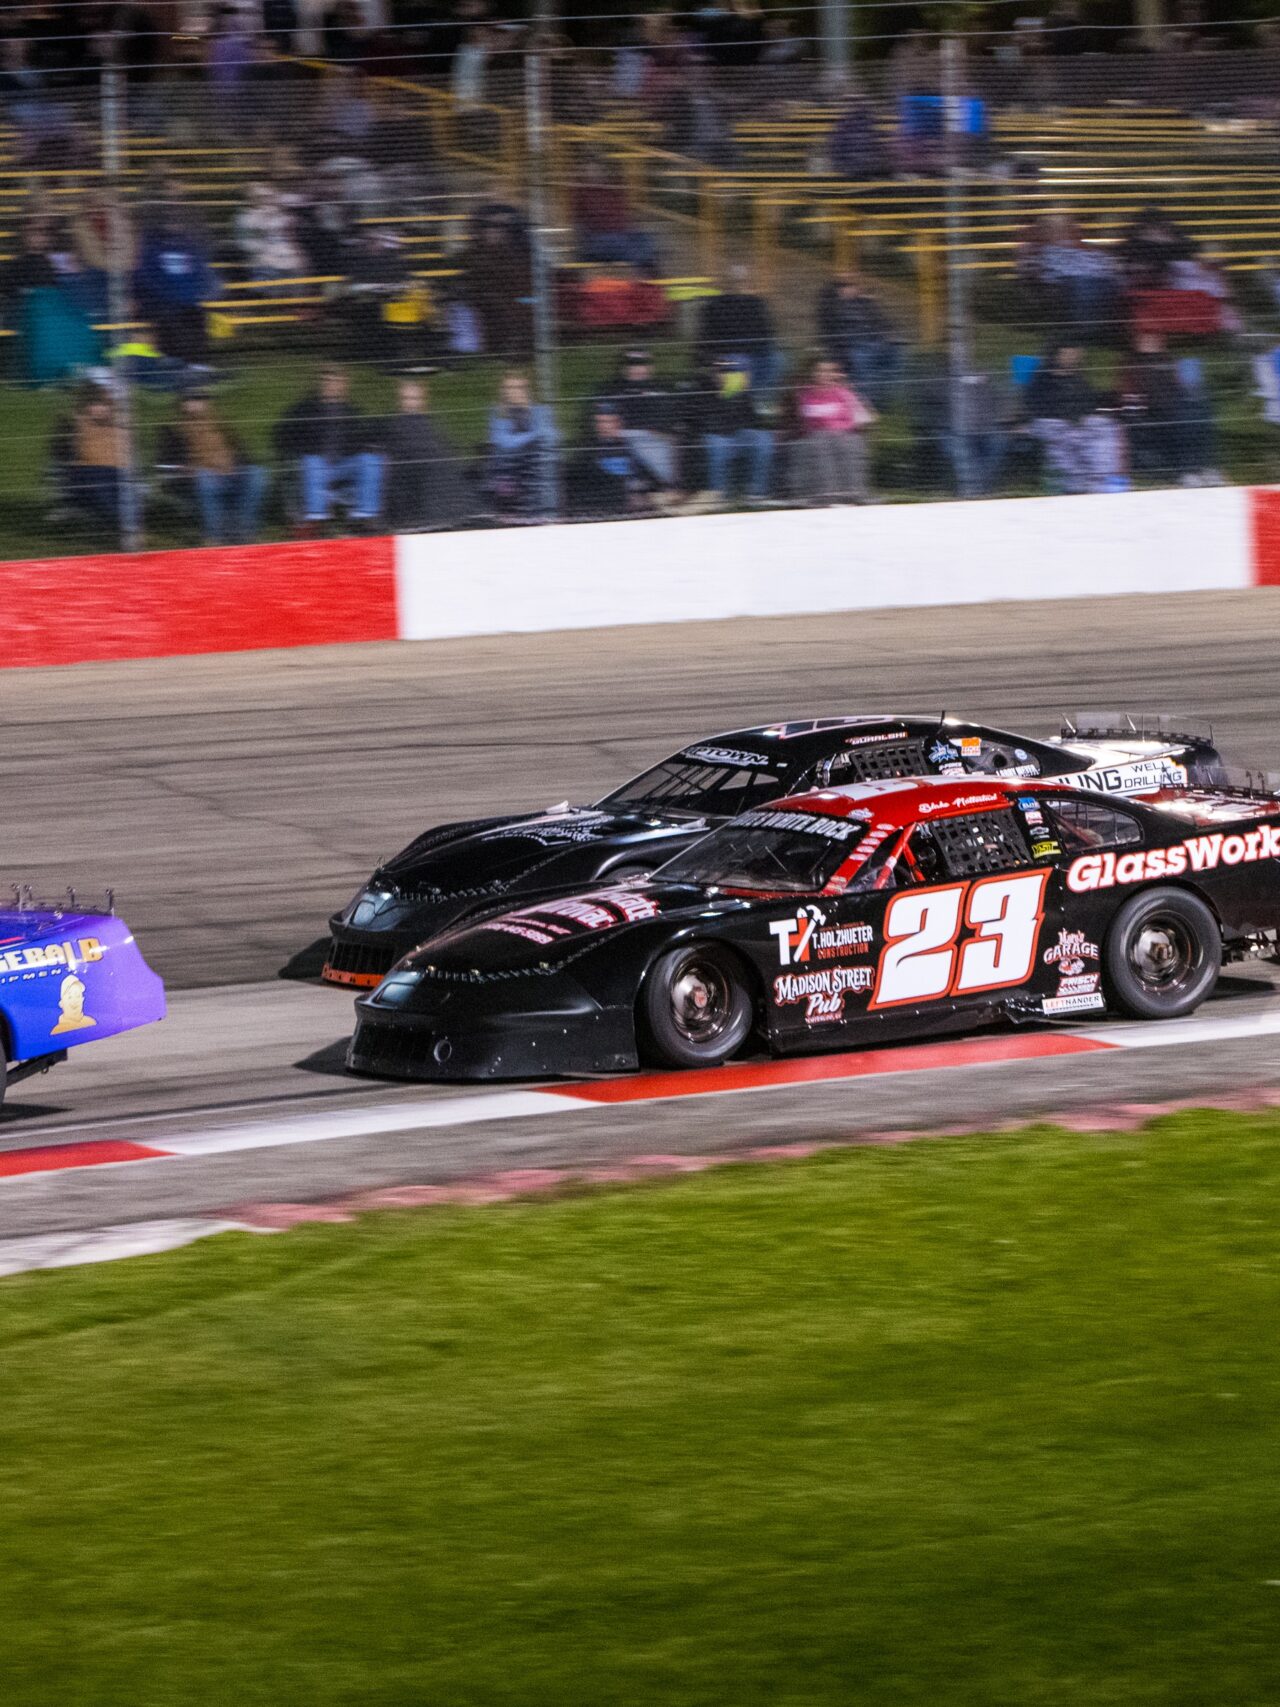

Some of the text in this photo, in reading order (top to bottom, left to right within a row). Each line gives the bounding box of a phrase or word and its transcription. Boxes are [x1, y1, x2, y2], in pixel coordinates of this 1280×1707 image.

[1131, 760, 1171, 773] WELL
[1124, 771, 1182, 789] DRILLING
[803, 816, 862, 841] ROCK
[817, 942, 869, 960] CONSTRUCTION
[867, 870, 1052, 1011] 23
[1043, 941, 1100, 965] GARAGE
[775, 967, 873, 1003] MADISON STREET
[806, 992, 842, 1016] Pub
